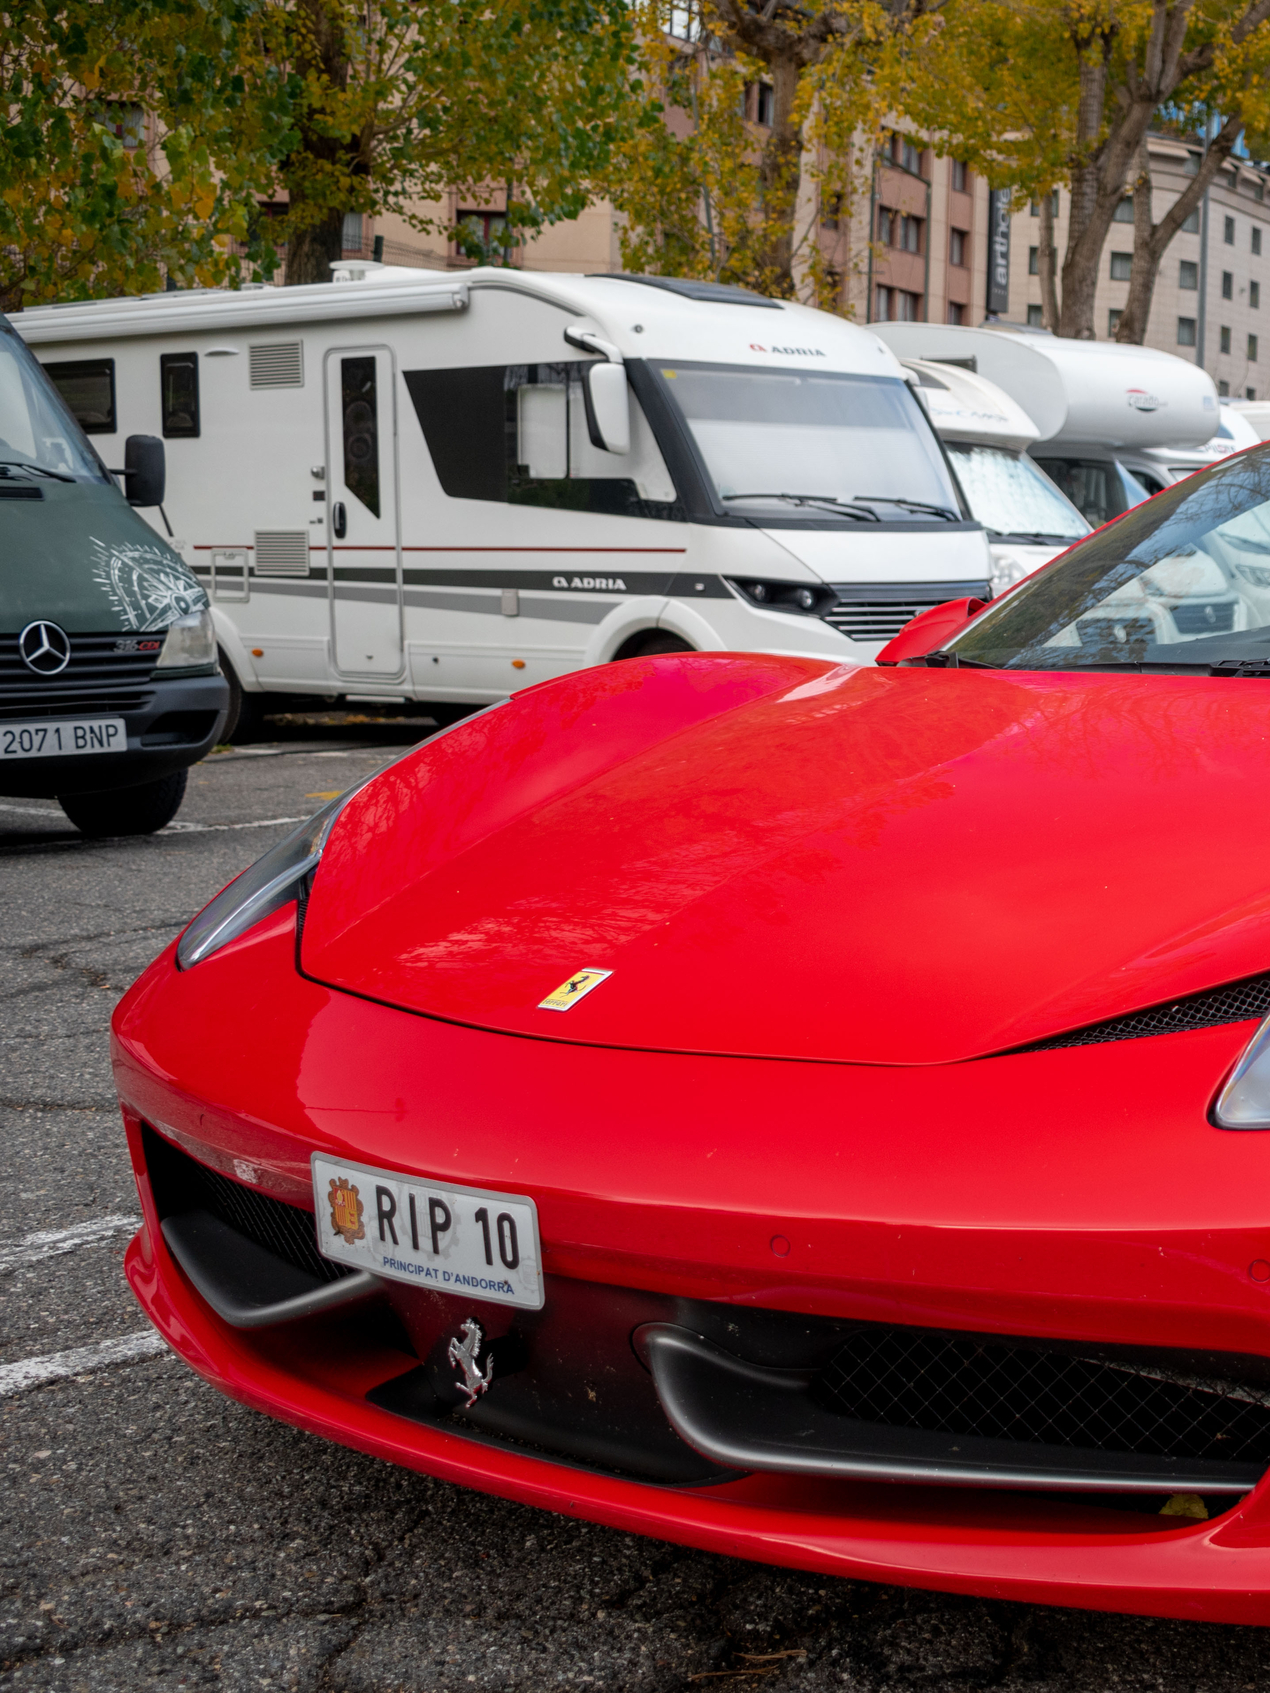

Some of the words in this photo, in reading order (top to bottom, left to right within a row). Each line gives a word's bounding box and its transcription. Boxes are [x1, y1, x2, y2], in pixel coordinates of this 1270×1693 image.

[993, 187, 1011, 286] arthote
[771, 345, 827, 357] ADRIA
[570, 576, 627, 591] ADRIA
[3, 727, 63, 754] 2071
[73, 723, 119, 750] BNP
[375, 1184, 453, 1255] RIP
[474, 1206, 520, 1270] 10
[383, 1255, 440, 1280] PRINCIPAT
[442, 1271, 515, 1295] D'ANDORRA
